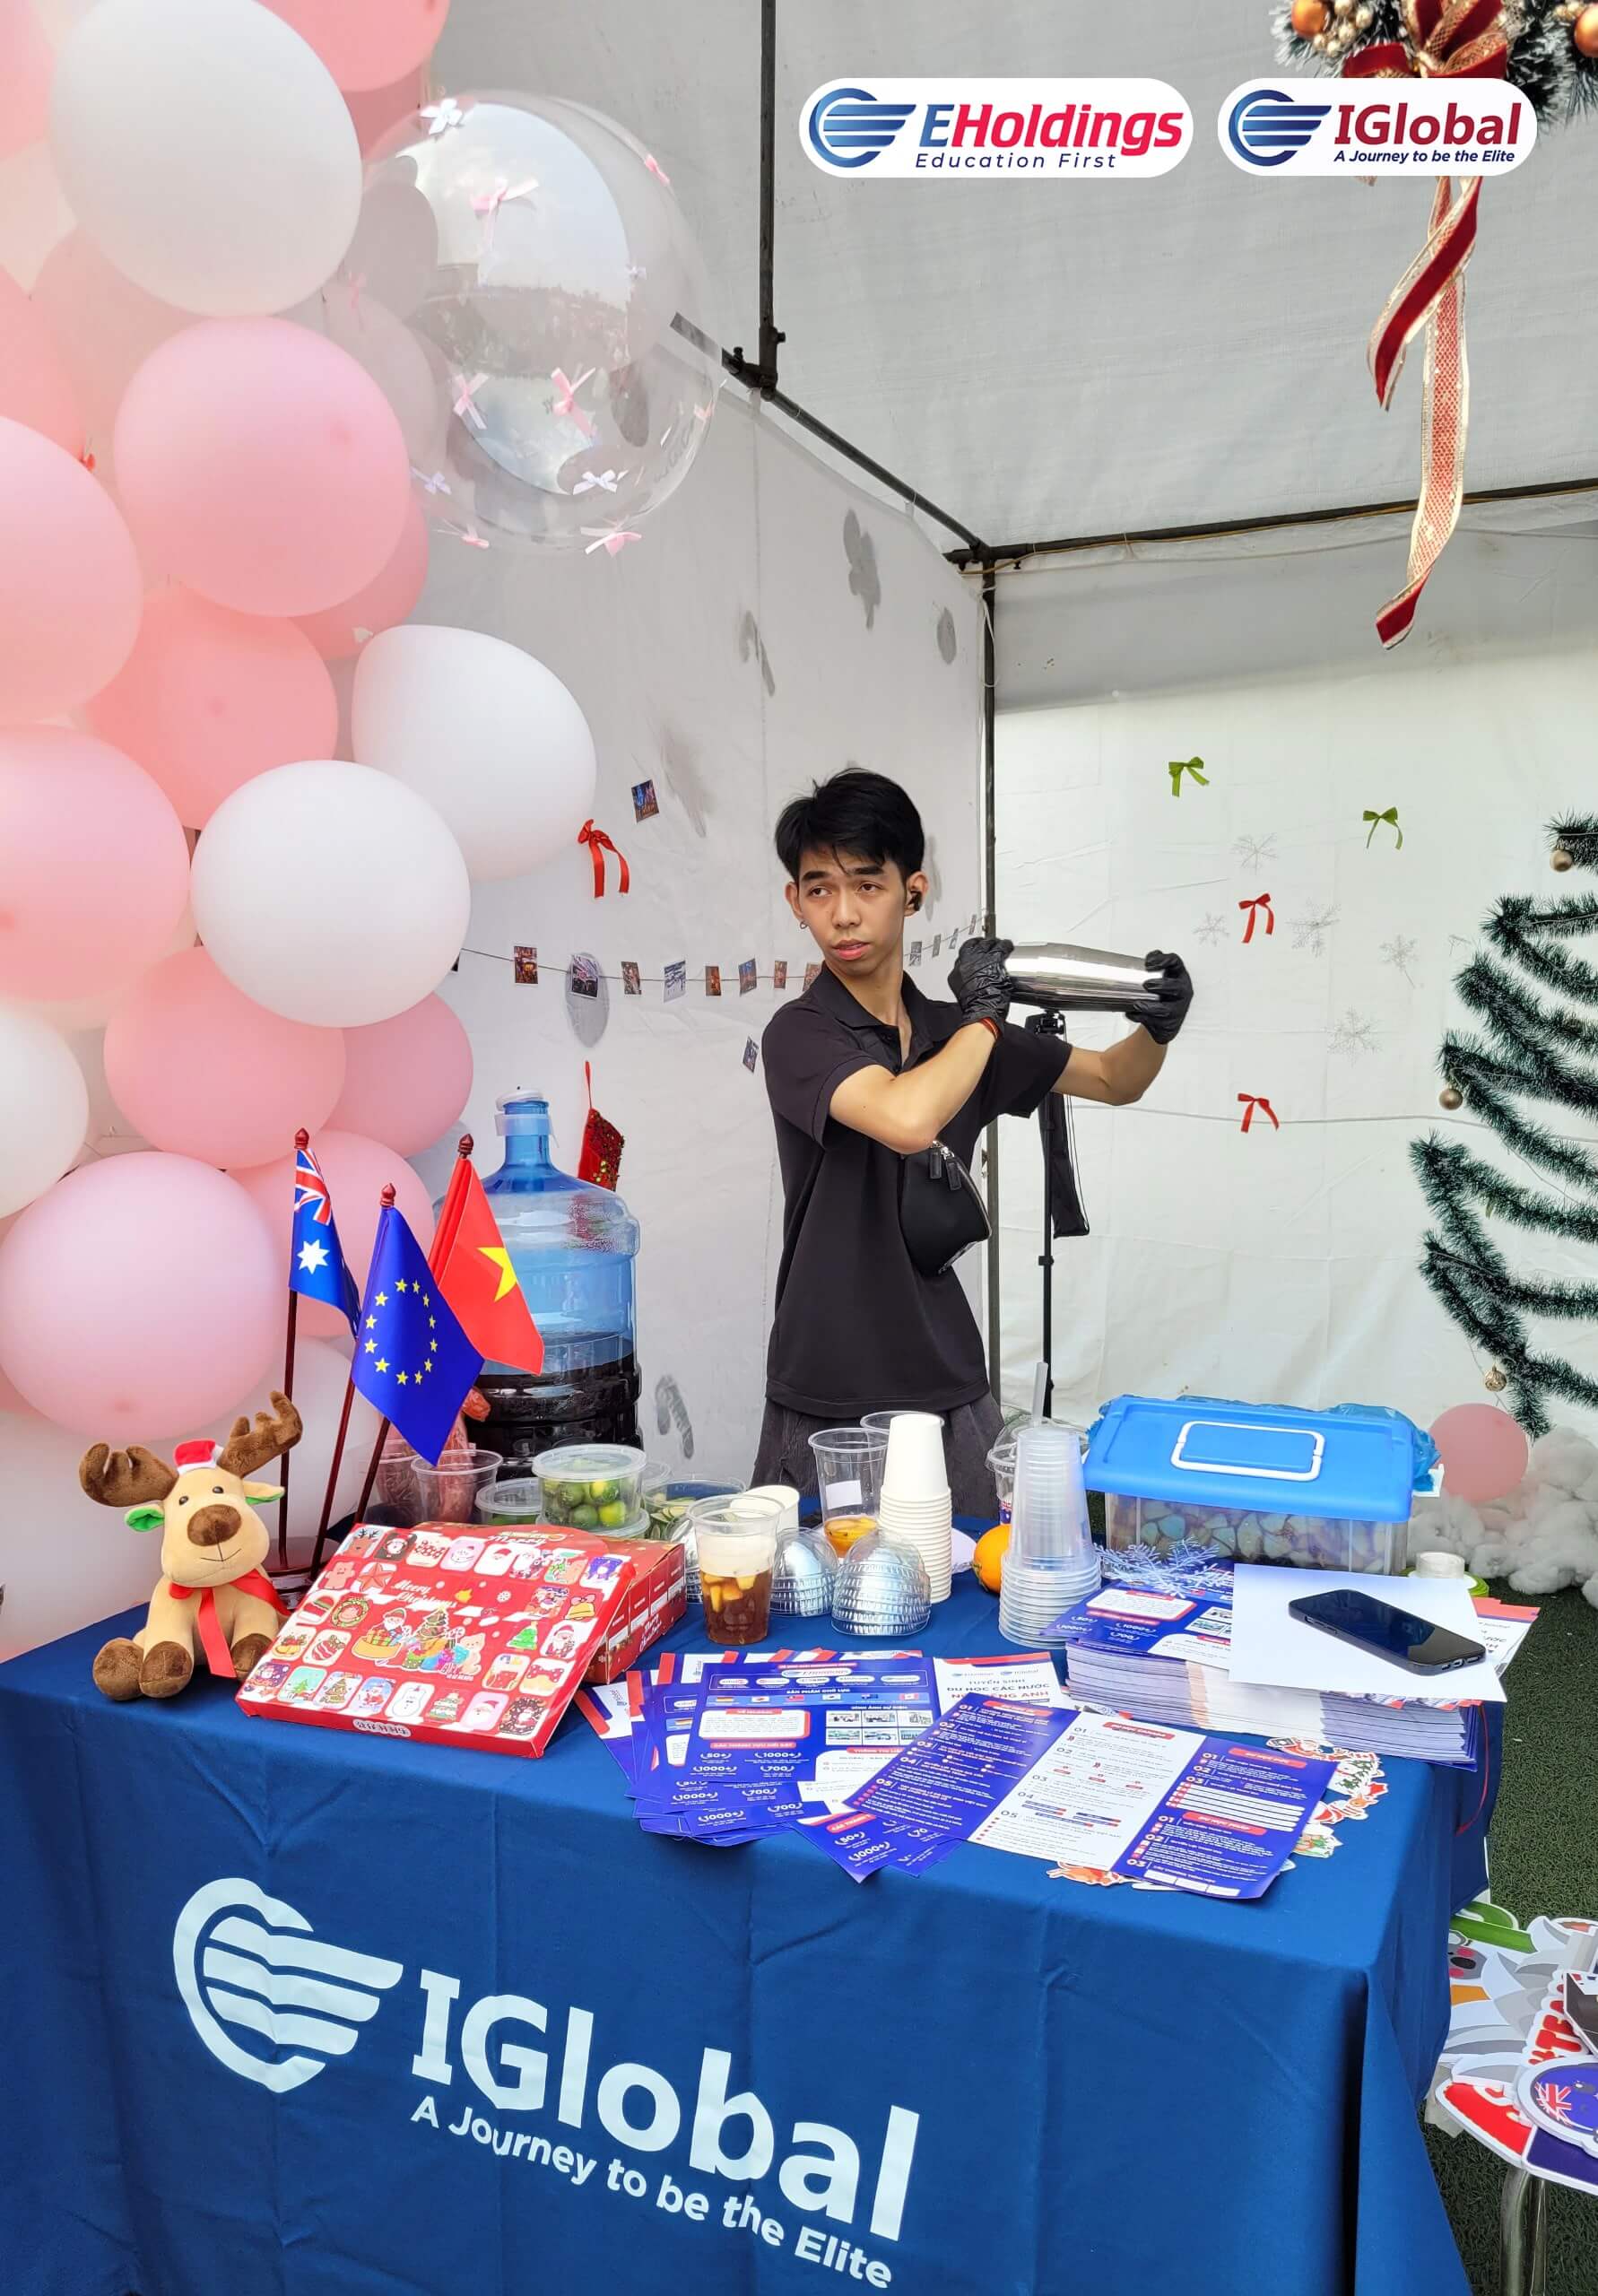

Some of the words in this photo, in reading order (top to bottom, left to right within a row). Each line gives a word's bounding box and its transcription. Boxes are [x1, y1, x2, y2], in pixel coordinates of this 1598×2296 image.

[939, 1721, 955, 1729] 02
[899, 1756, 916, 1765] 04
[1194, 1764, 1211, 1773] 02
[1032, 1774, 1048, 1782] 03
[1185, 1776, 1204, 1785] 03
[875, 1779, 892, 1787] 05
[1018, 1791, 1034, 1799] 04
[1001, 1810, 1018, 1818] 05
[1158, 1815, 1175, 1823] 01
[1144, 1833, 1164, 1842] 02
[1126, 1858, 1147, 1867] 03
[411, 1968, 919, 2241] IGlobal
[410, 2095, 439, 2129] A
[448, 2106, 597, 2186] Journey
[607, 2158, 647, 2197] to
[656, 2174, 709, 2221] be
[722, 2195, 785, 2247] the
[794, 2225, 891, 2289] Elite
